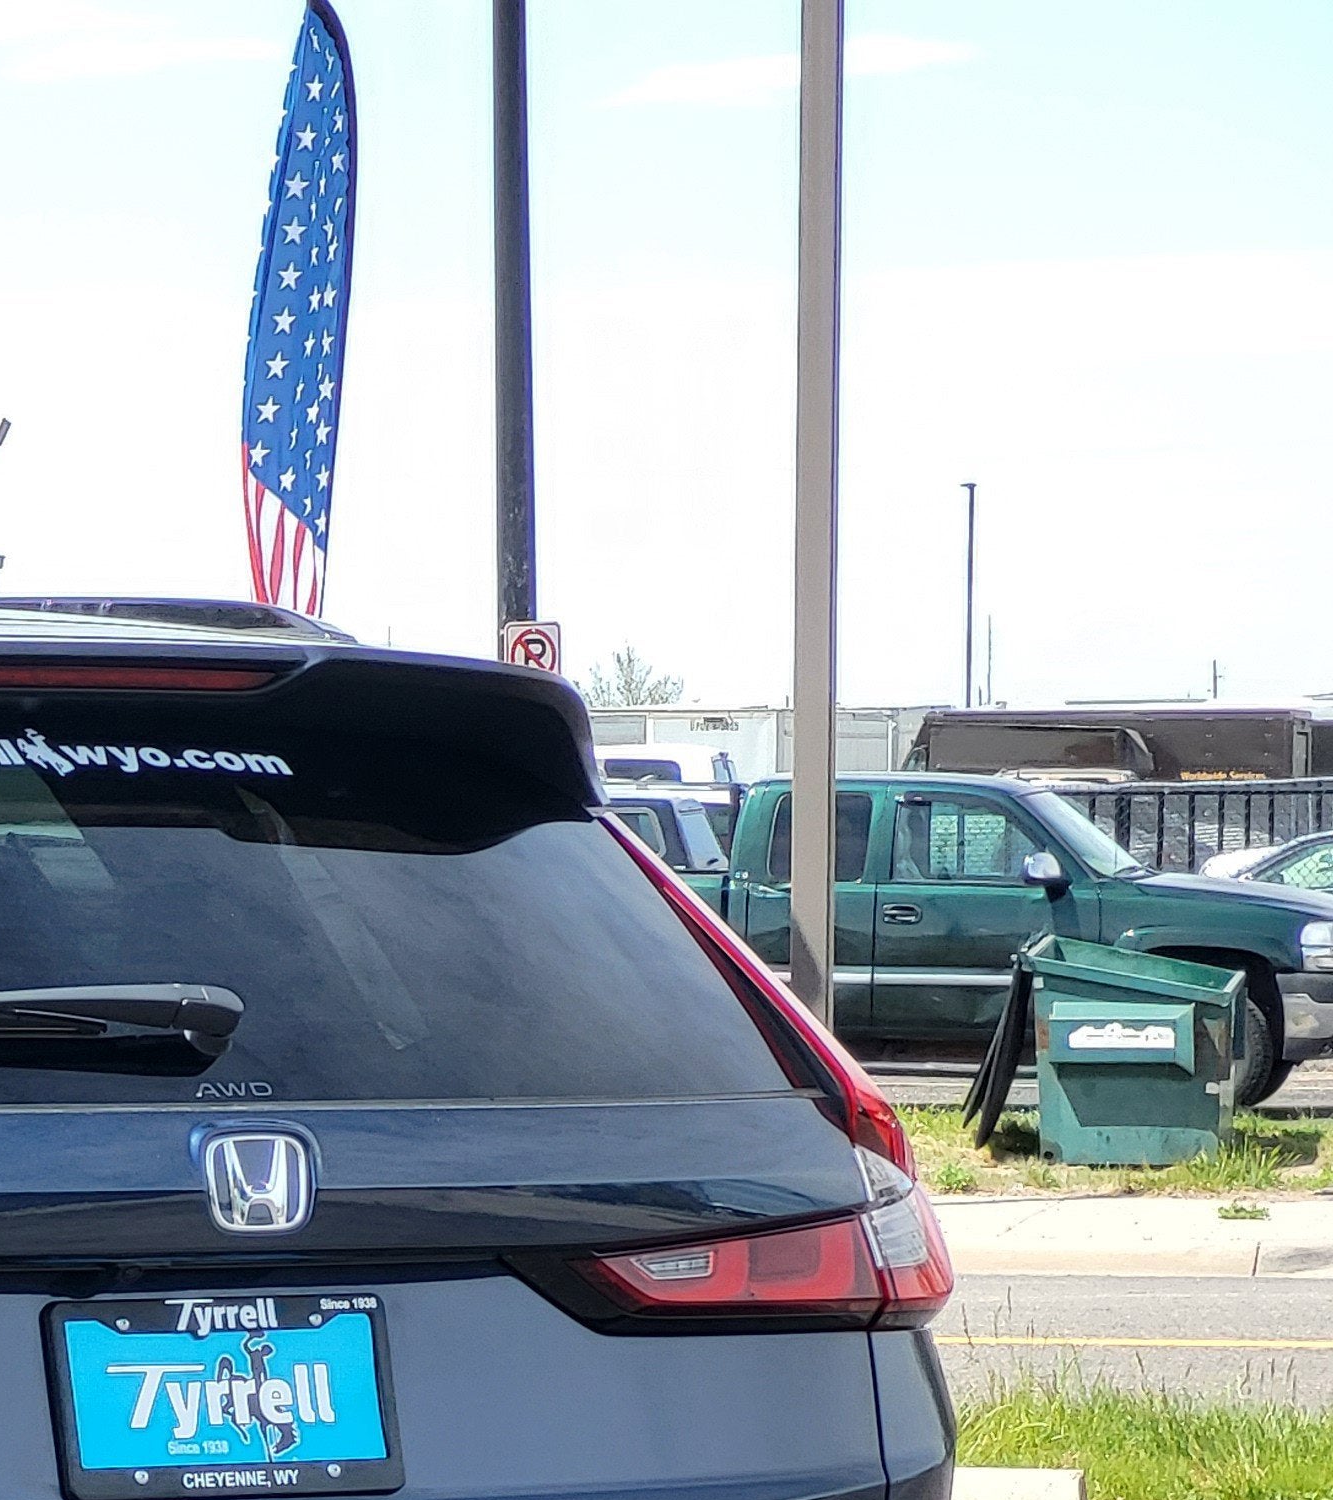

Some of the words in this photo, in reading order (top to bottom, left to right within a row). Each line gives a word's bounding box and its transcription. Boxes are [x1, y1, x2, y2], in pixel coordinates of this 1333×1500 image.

[196, 1082, 273, 1098] AWD
[320, 1298, 350, 1310] Since
[352, 1297, 378, 1309] 1938
[164, 1298, 278, 1336] Tyrrell
[106, 1363, 336, 1439] Tyrrell
[168, 1441, 201, 1455] Since
[182, 1471, 272, 1489] CHEYENNE,
[273, 1469, 300, 1485] WY
